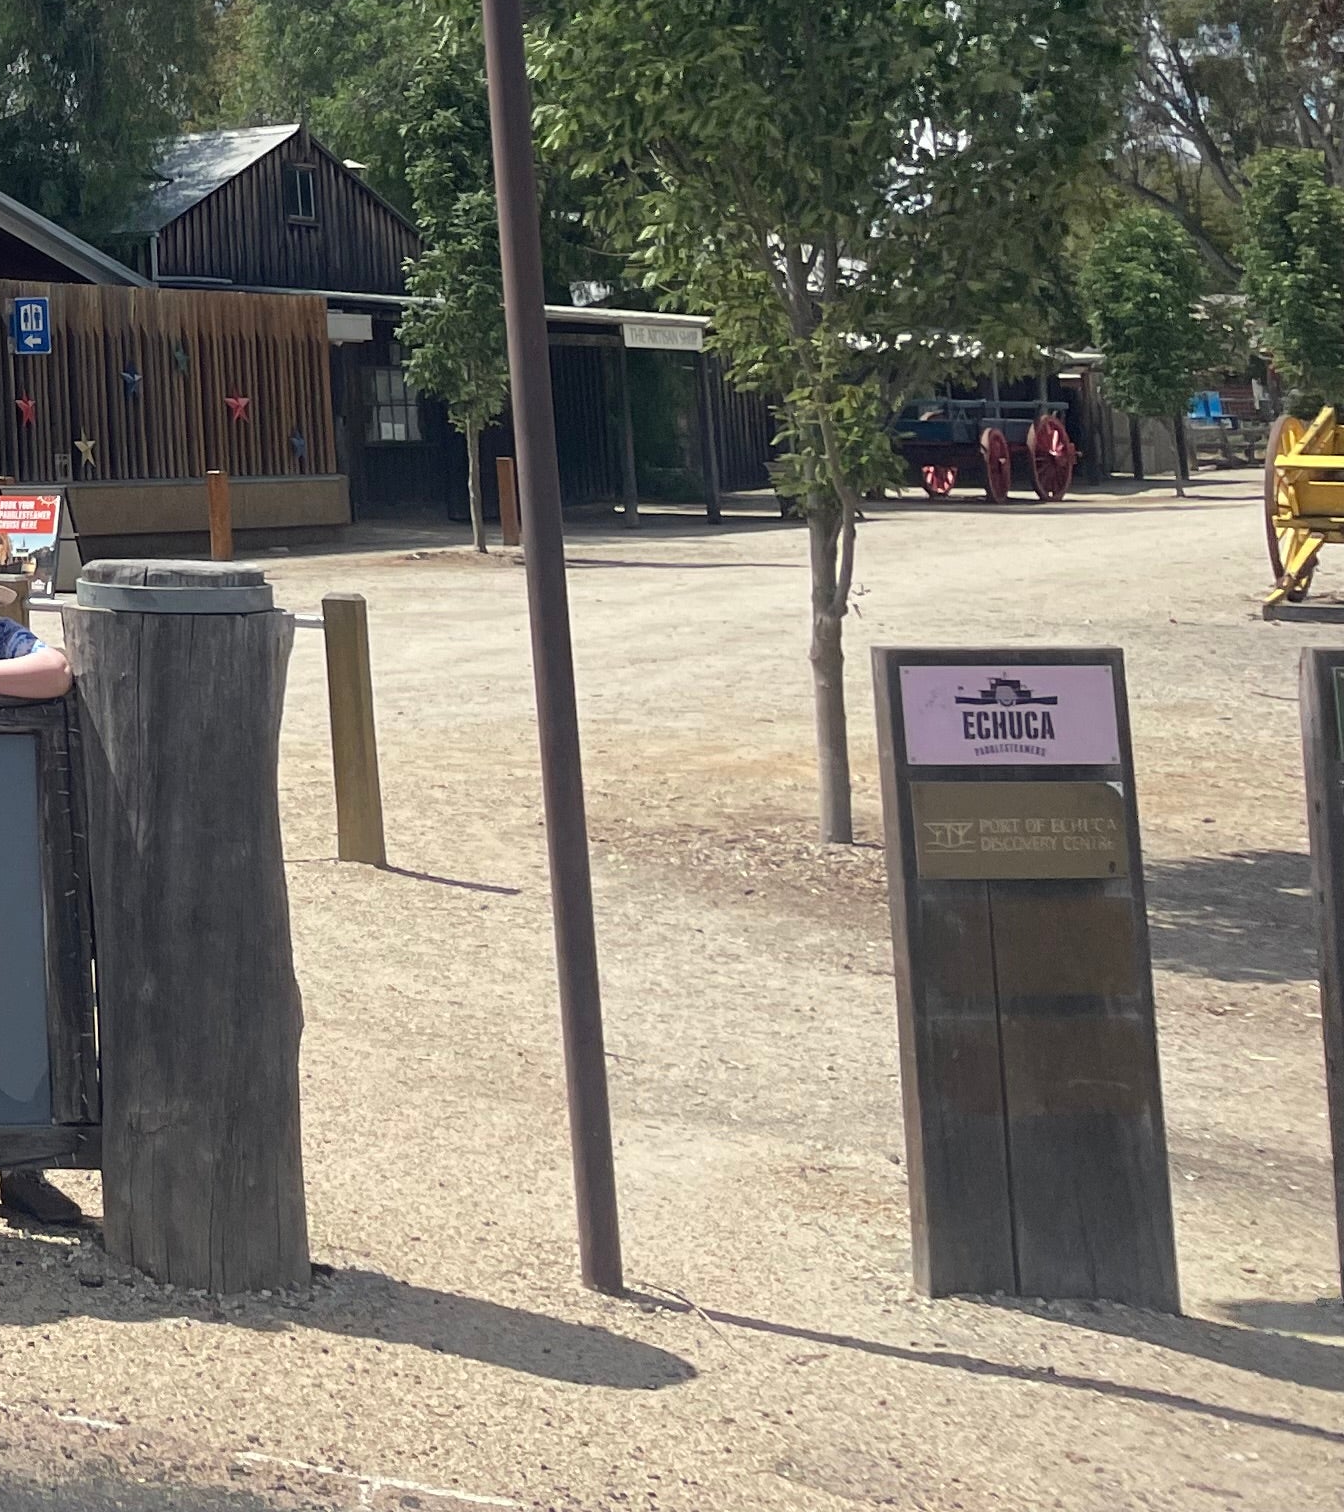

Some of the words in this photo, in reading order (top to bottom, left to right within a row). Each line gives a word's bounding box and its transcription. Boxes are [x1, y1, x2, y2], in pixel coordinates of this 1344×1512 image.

[629, 328, 646, 344] THE
[962, 711, 1056, 740] ECHUCA
[979, 818, 1020, 833] PORT
[1025, 818, 1048, 833] OF
[1050, 817, 1117, 833] ECHUCA
[980, 835, 1057, 851] DISCOVERY
